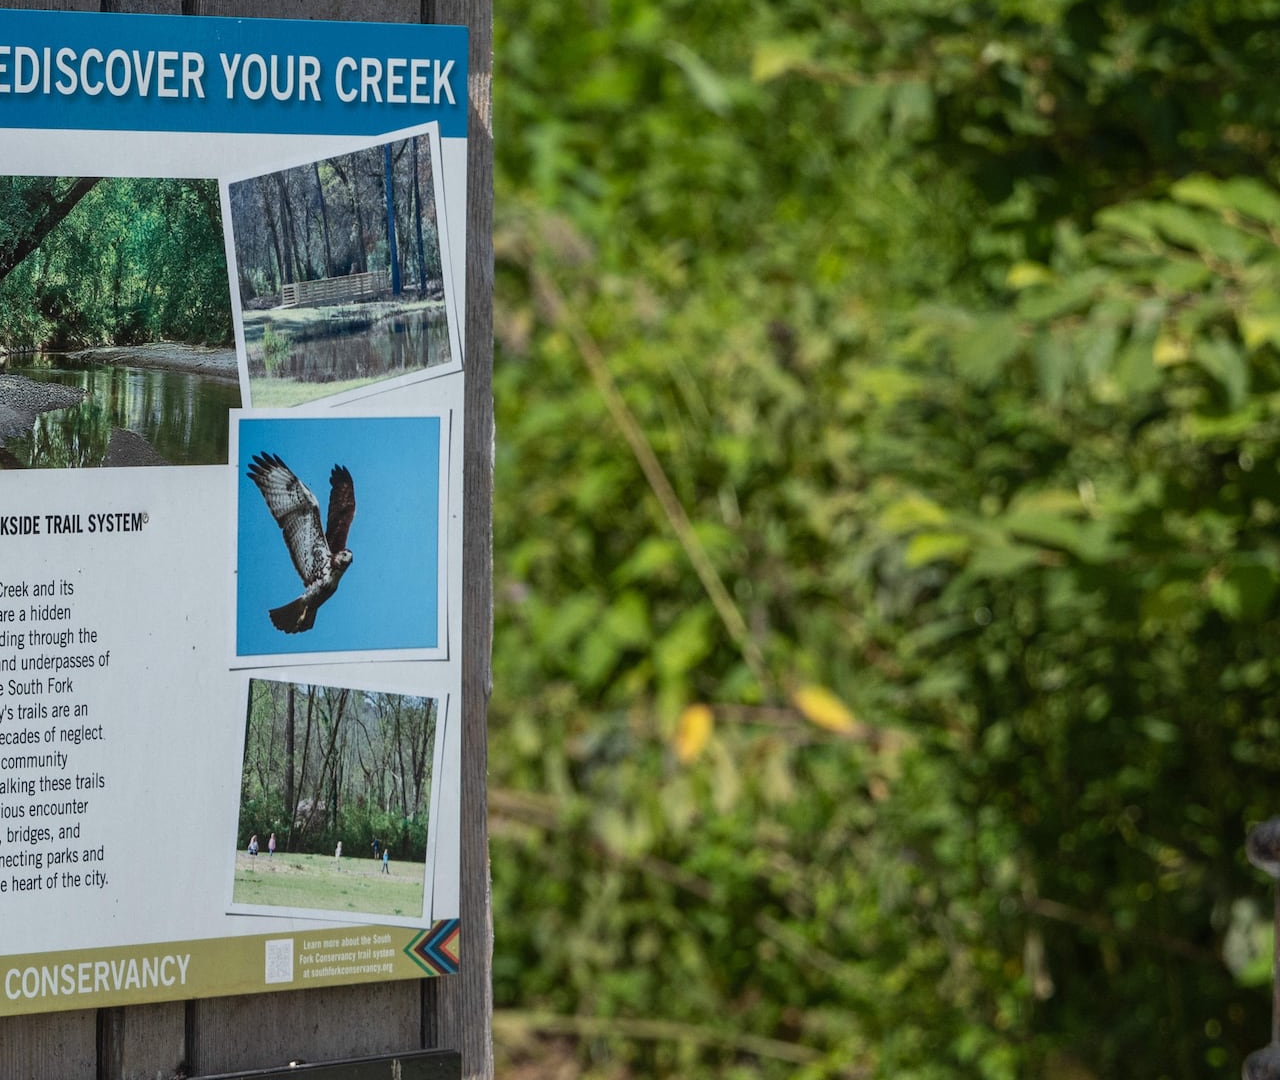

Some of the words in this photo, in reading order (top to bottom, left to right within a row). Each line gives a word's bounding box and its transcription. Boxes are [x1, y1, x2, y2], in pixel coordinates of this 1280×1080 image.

[220, 52, 321, 102] YOUR
[335, 56, 455, 104] CREEK
[46, 515, 83, 534] TRAIL
[33, 580, 54, 596] and
[60, 580, 74, 595] its
[19, 609, 26, 621] a
[31, 605, 70, 621] hidden
[29, 629, 73, 648] through
[78, 628, 97, 643] the
[21, 654, 94, 672] underpasses
[98, 651, 110, 667] of
[8, 679, 42, 695] South
[48, 677, 73, 693] Fork
[18, 703, 47, 719] trails
[52, 706, 69, 718] are
[74, 704, 87, 716] an
[5, 954, 191, 1000] CONSERVANCY
